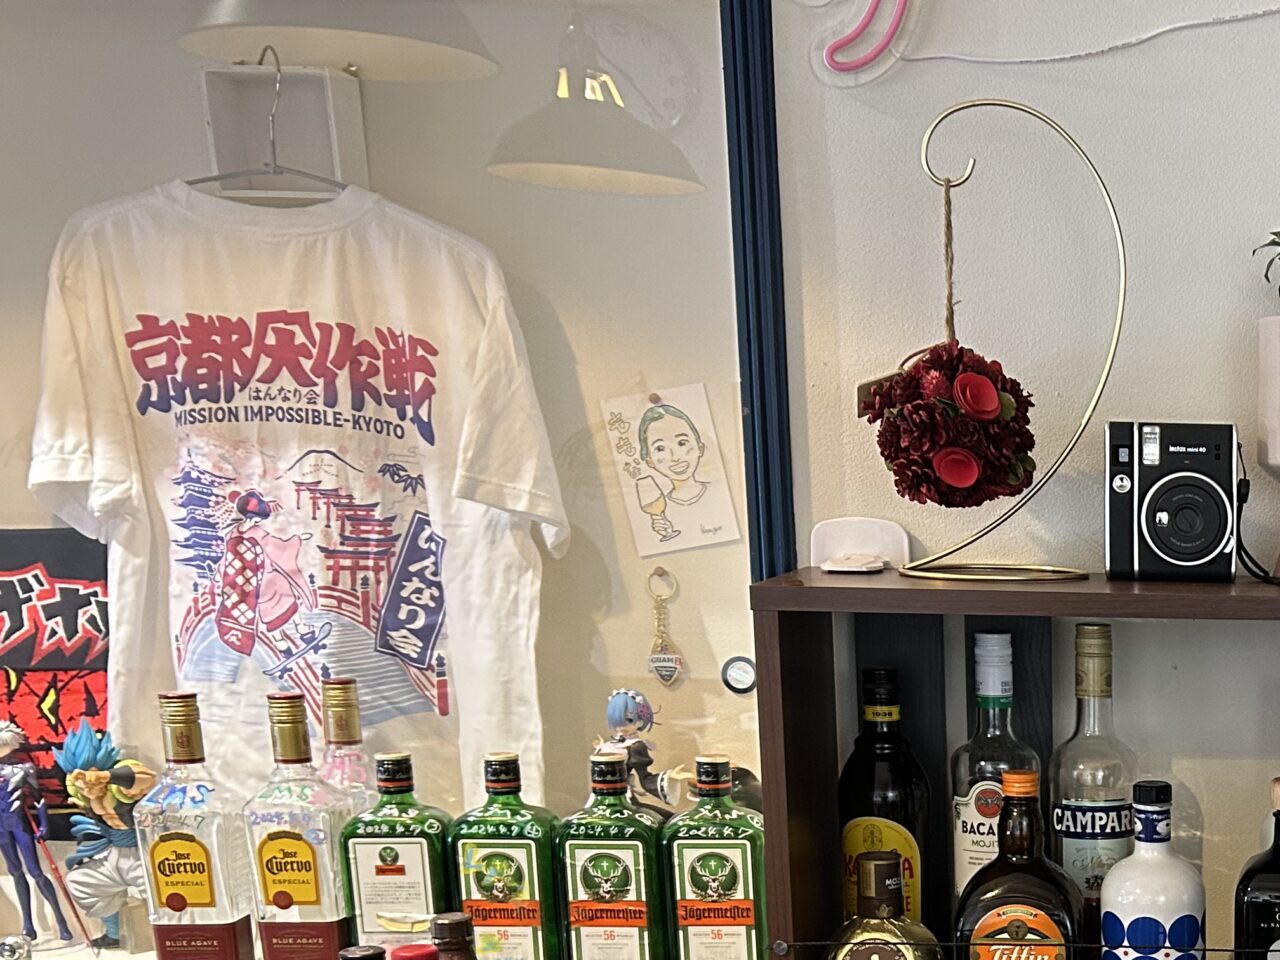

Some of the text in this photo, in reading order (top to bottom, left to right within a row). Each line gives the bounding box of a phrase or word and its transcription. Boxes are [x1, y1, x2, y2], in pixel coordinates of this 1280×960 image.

[174, 406, 405, 439] MISSION IMPOSSIBLE-KYOTO
[1054, 808, 1134, 833] CAMPAR
[962, 821, 996, 836] BACA
[158, 858, 205, 876] Cuervo
[266, 856, 312, 875] Cuervo
[467, 906, 538, 921] Jägermeister
[573, 906, 644, 921] Jägermeister
[681, 906, 751, 920] Jägermeister
[497, 929, 509, 941] 56
[603, 930, 615, 941] 56
[711, 930, 723, 940] 56
